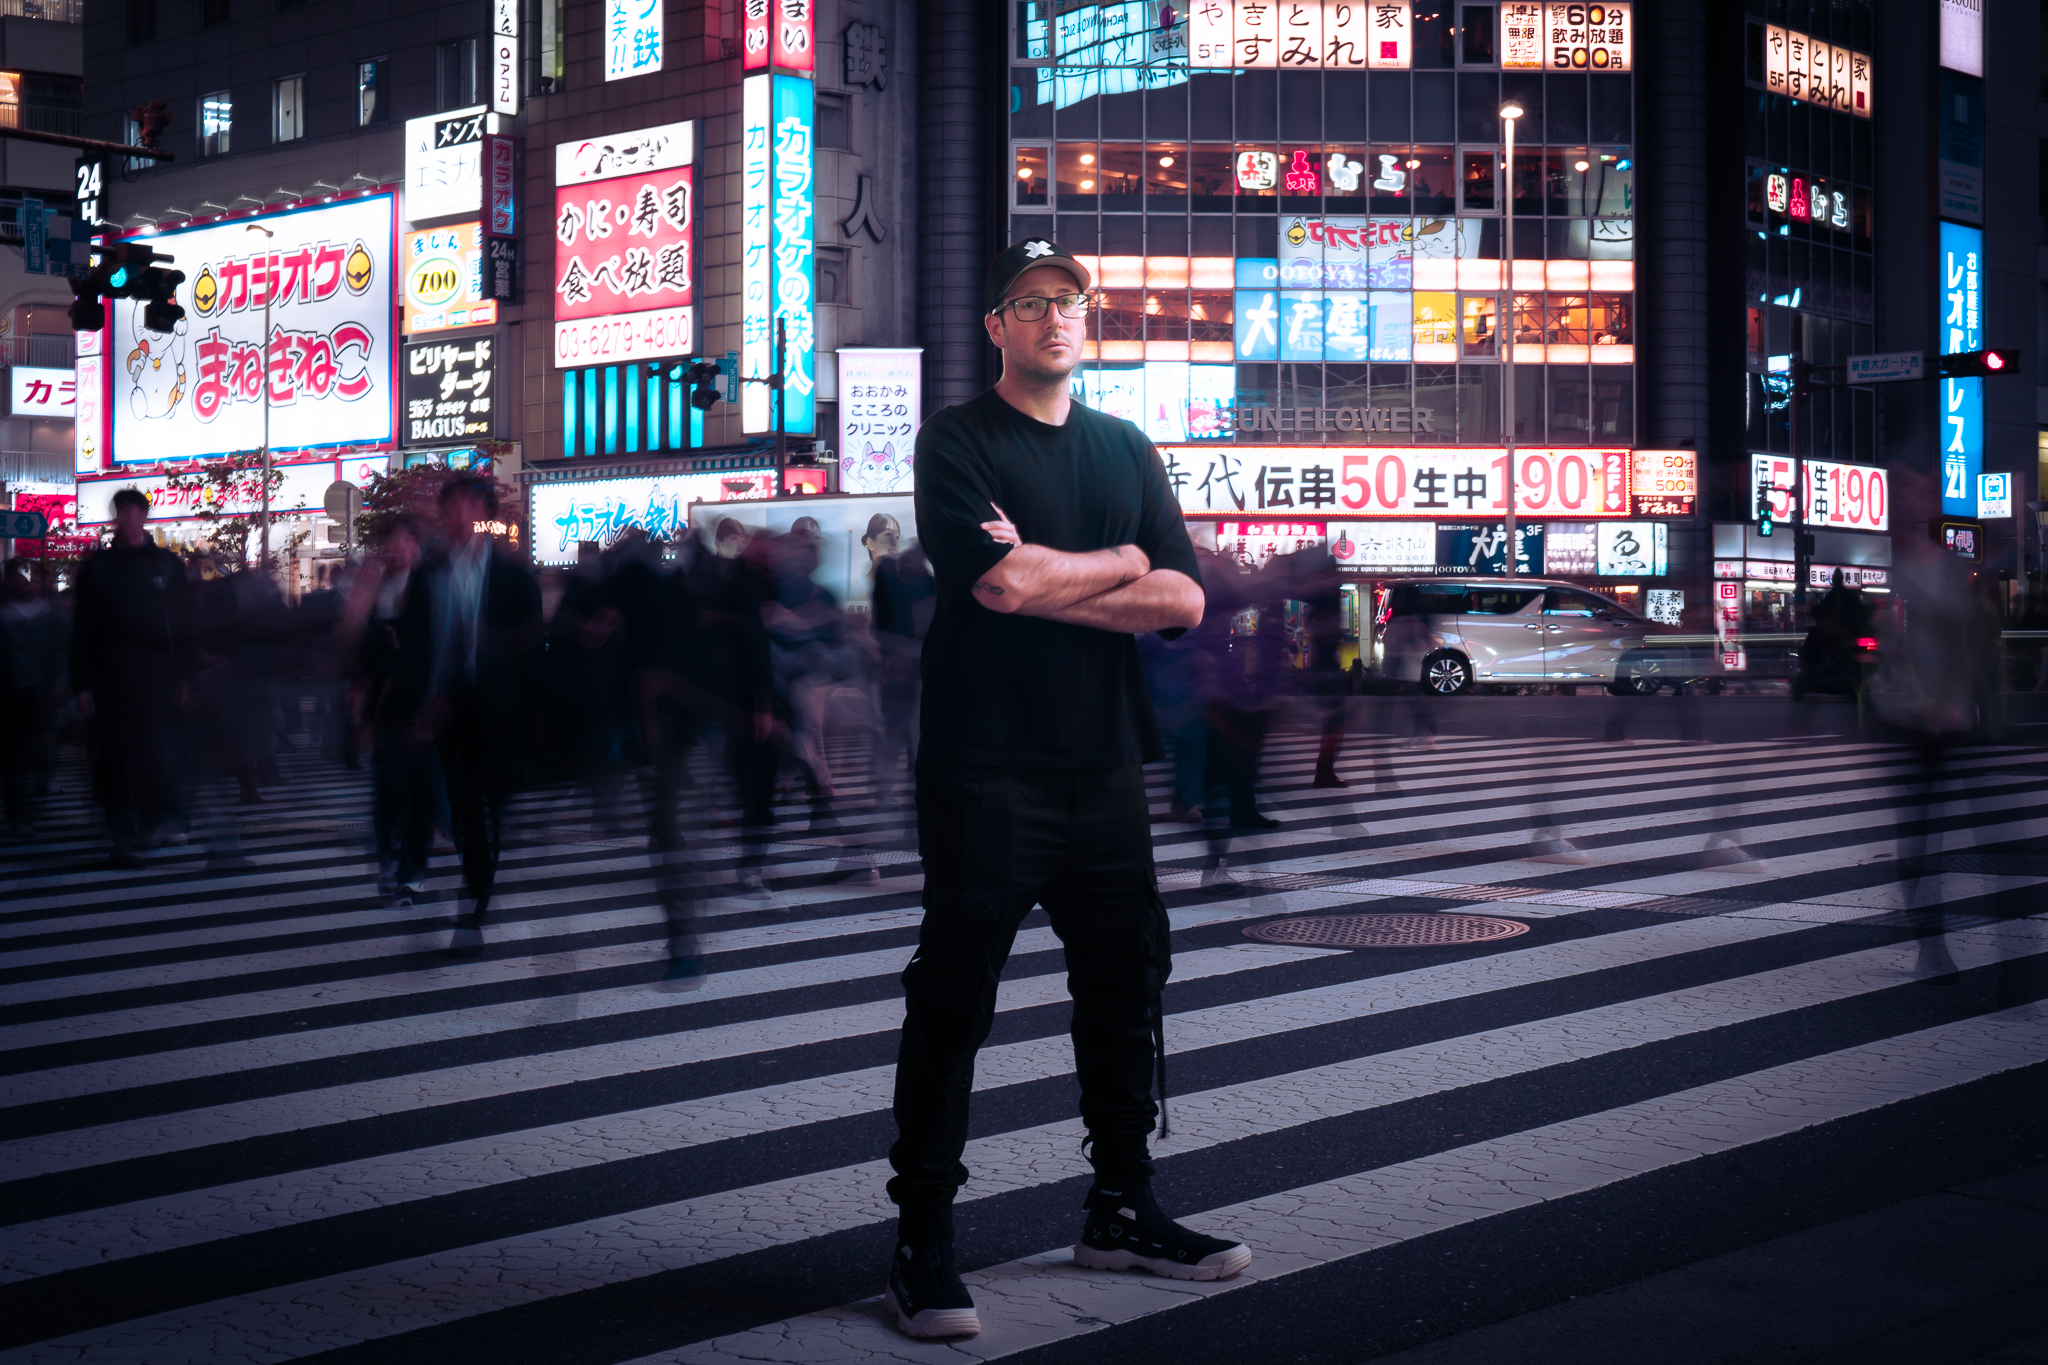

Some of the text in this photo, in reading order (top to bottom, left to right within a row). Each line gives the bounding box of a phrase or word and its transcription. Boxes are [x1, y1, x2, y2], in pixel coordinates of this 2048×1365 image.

[1198, 3, 1404, 29] やきとり家
[1198, 43, 1226, 59] 5F
[1236, 35, 1364, 66] すみれ
[1552, 28, 1624, 44] 飲み放題
[1769, 31, 1868, 82] やきとり家
[1770, 71, 1785, 89] 5F
[1788, 68, 1850, 110] すみれ
[438, 114, 484, 147] メンズ
[78, 163, 102, 200] 24
[494, 141, 511, 231] カラオケ
[746, 122, 768, 390] カラオケの鉄人
[775, 117, 814, 395] カラオケの鉄人
[217, 244, 346, 314] カラオケ
[417, 269, 457, 294] ZOO
[494, 260, 510, 298] 営業
[558, 243, 690, 302] 食べ放題
[1262, 265, 1355, 281] OOTOYA
[558, 314, 689, 360] 03-6279-4800
[1241, 292, 1368, 357] 大戸屋
[410, 340, 491, 375] ビリヤード
[1852, 356, 1919, 372] 新宿大ガード西
[193, 327, 372, 420] まねきねこ
[439, 370, 491, 400] ダーツ
[850, 385, 908, 398] おおかみ
[851, 404, 908, 417] こころの
[1294, 406, 1435, 433] FLOWER
[411, 416, 466, 439] BAGUS
[846, 422, 912, 436] クリニック
[1254, 464, 1336, 510] 伝串
[1340, 454, 1408, 510] 50
[1413, 467, 1487, 510] 生中
[1490, 454, 1590, 511] 190
[1814, 465, 1829, 523] 生中
[1829, 467, 1885, 527] 190
[1638, 502, 1680, 515] すみれ
[1526, 525, 1543, 537] 3F
[1360, 553, 1428, 561] Rokkasen
[1438, 566, 1477, 574] OOTOYA
